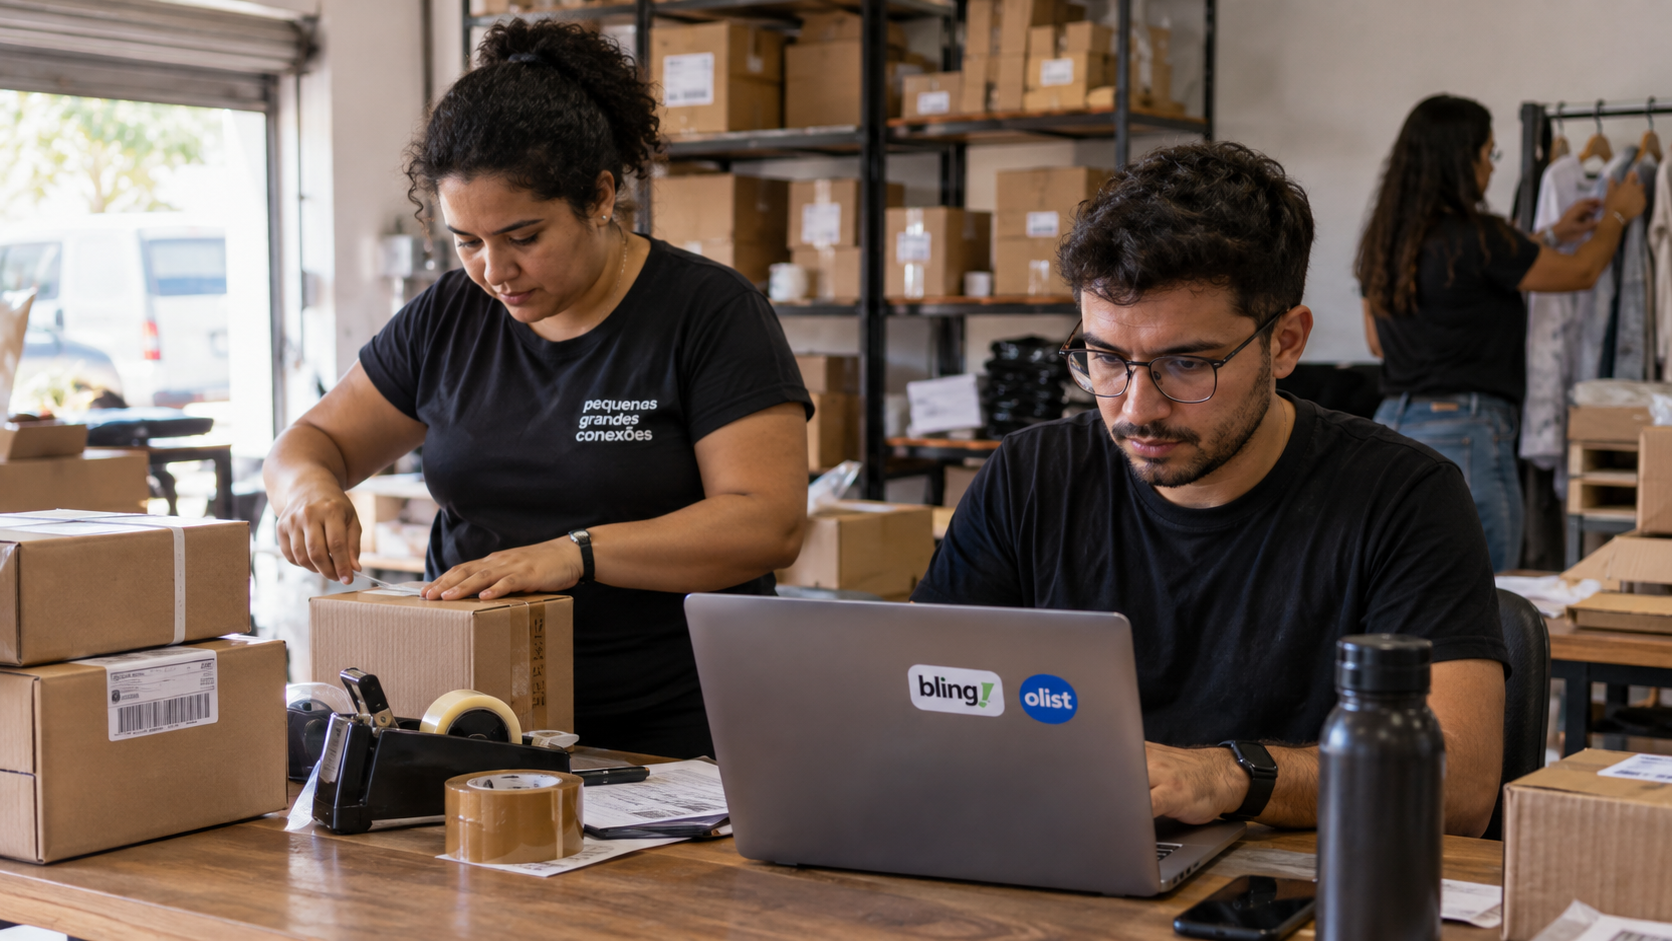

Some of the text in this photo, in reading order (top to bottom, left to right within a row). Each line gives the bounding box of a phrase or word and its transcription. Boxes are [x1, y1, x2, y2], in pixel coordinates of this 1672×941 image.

[582, 399, 658, 414] pequenas
[578, 412, 639, 429] grandes
[575, 426, 653, 442] conexões
[918, 674, 995, 709] bling!
[1024, 687, 1073, 710] olist
